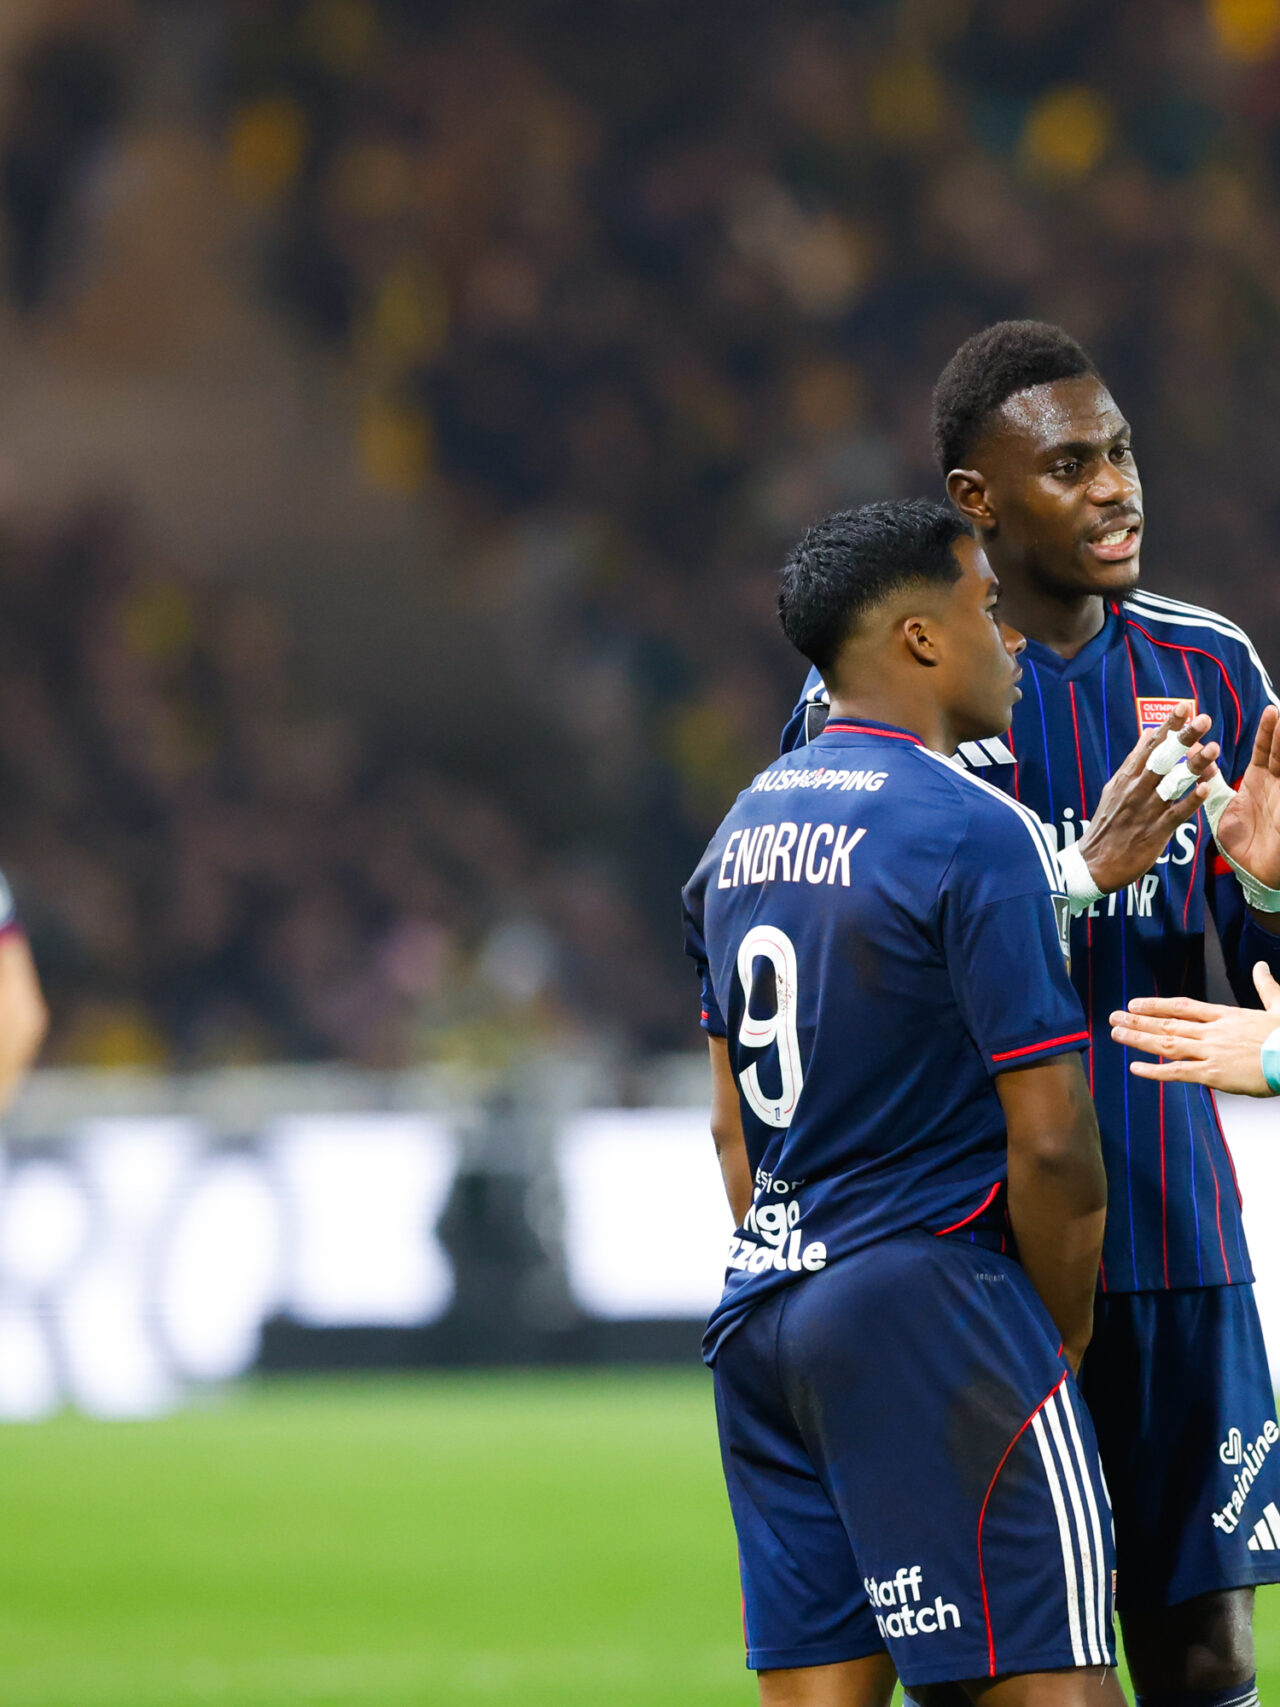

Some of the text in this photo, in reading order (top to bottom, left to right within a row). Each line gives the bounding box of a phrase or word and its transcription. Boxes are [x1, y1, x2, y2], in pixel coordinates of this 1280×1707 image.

[717, 821, 867, 889] ENDRICK
[737, 924, 804, 1128] 9
[1211, 1420, 1280, 1534] trainline
